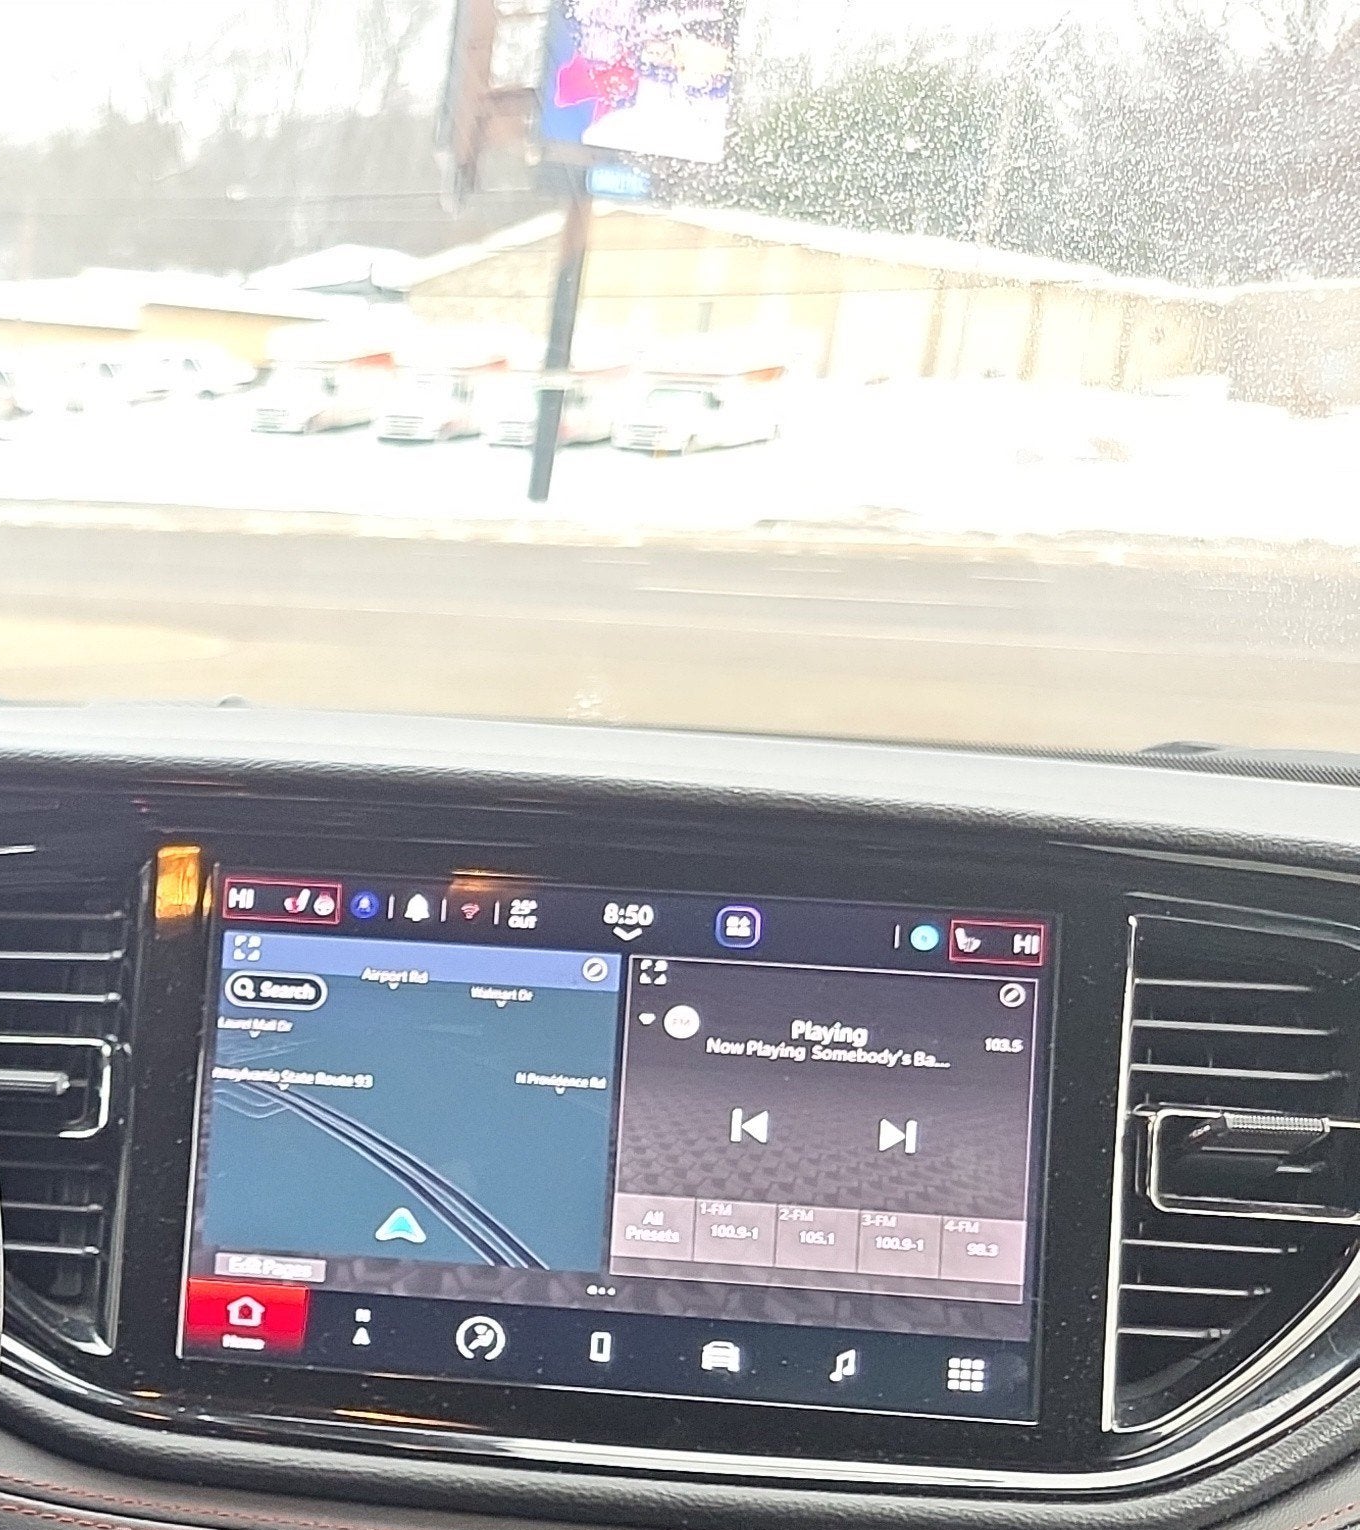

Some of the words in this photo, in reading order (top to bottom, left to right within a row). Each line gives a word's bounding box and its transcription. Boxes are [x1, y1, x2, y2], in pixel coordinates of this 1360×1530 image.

[229, 888, 255, 910] HI
[603, 903, 654, 926] 8:50
[1013, 933, 1040, 955] HI
[361, 966, 408, 983] Airport
[409, 970, 429, 984] Rd
[260, 980, 316, 1000] Search
[791, 1019, 868, 1046] Playing
[706, 1038, 745, 1055] Now
[746, 1041, 806, 1062] Playing
[811, 1045, 911, 1068] Somebody's
[589, 1076, 607, 1089] Rd
[699, 1202, 732, 1216] 1-FM
[779, 1208, 814, 1222] 2-FM
[642, 1211, 664, 1226] All
[862, 1213, 897, 1228] 3-FM
[944, 1219, 979, 1233] 4-FM
[625, 1226, 680, 1243] Presets
